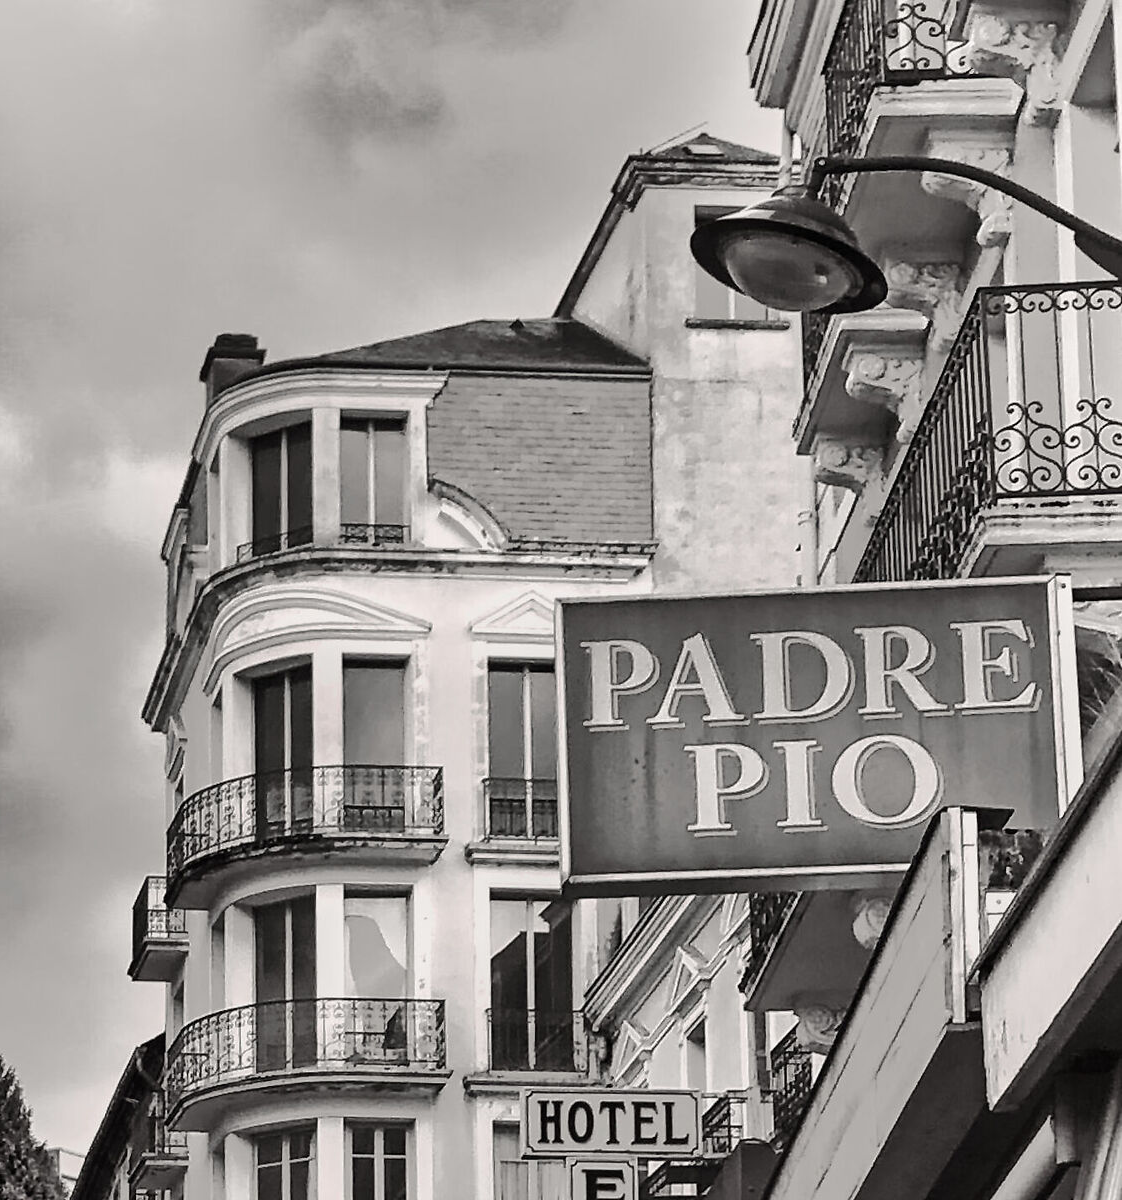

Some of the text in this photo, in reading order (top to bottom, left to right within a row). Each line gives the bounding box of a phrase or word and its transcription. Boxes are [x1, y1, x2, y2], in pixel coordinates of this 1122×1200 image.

[580, 619, 1042, 731] PADRE
[684, 733, 944, 837] PIO
[537, 1101, 689, 1145] HOTEL
